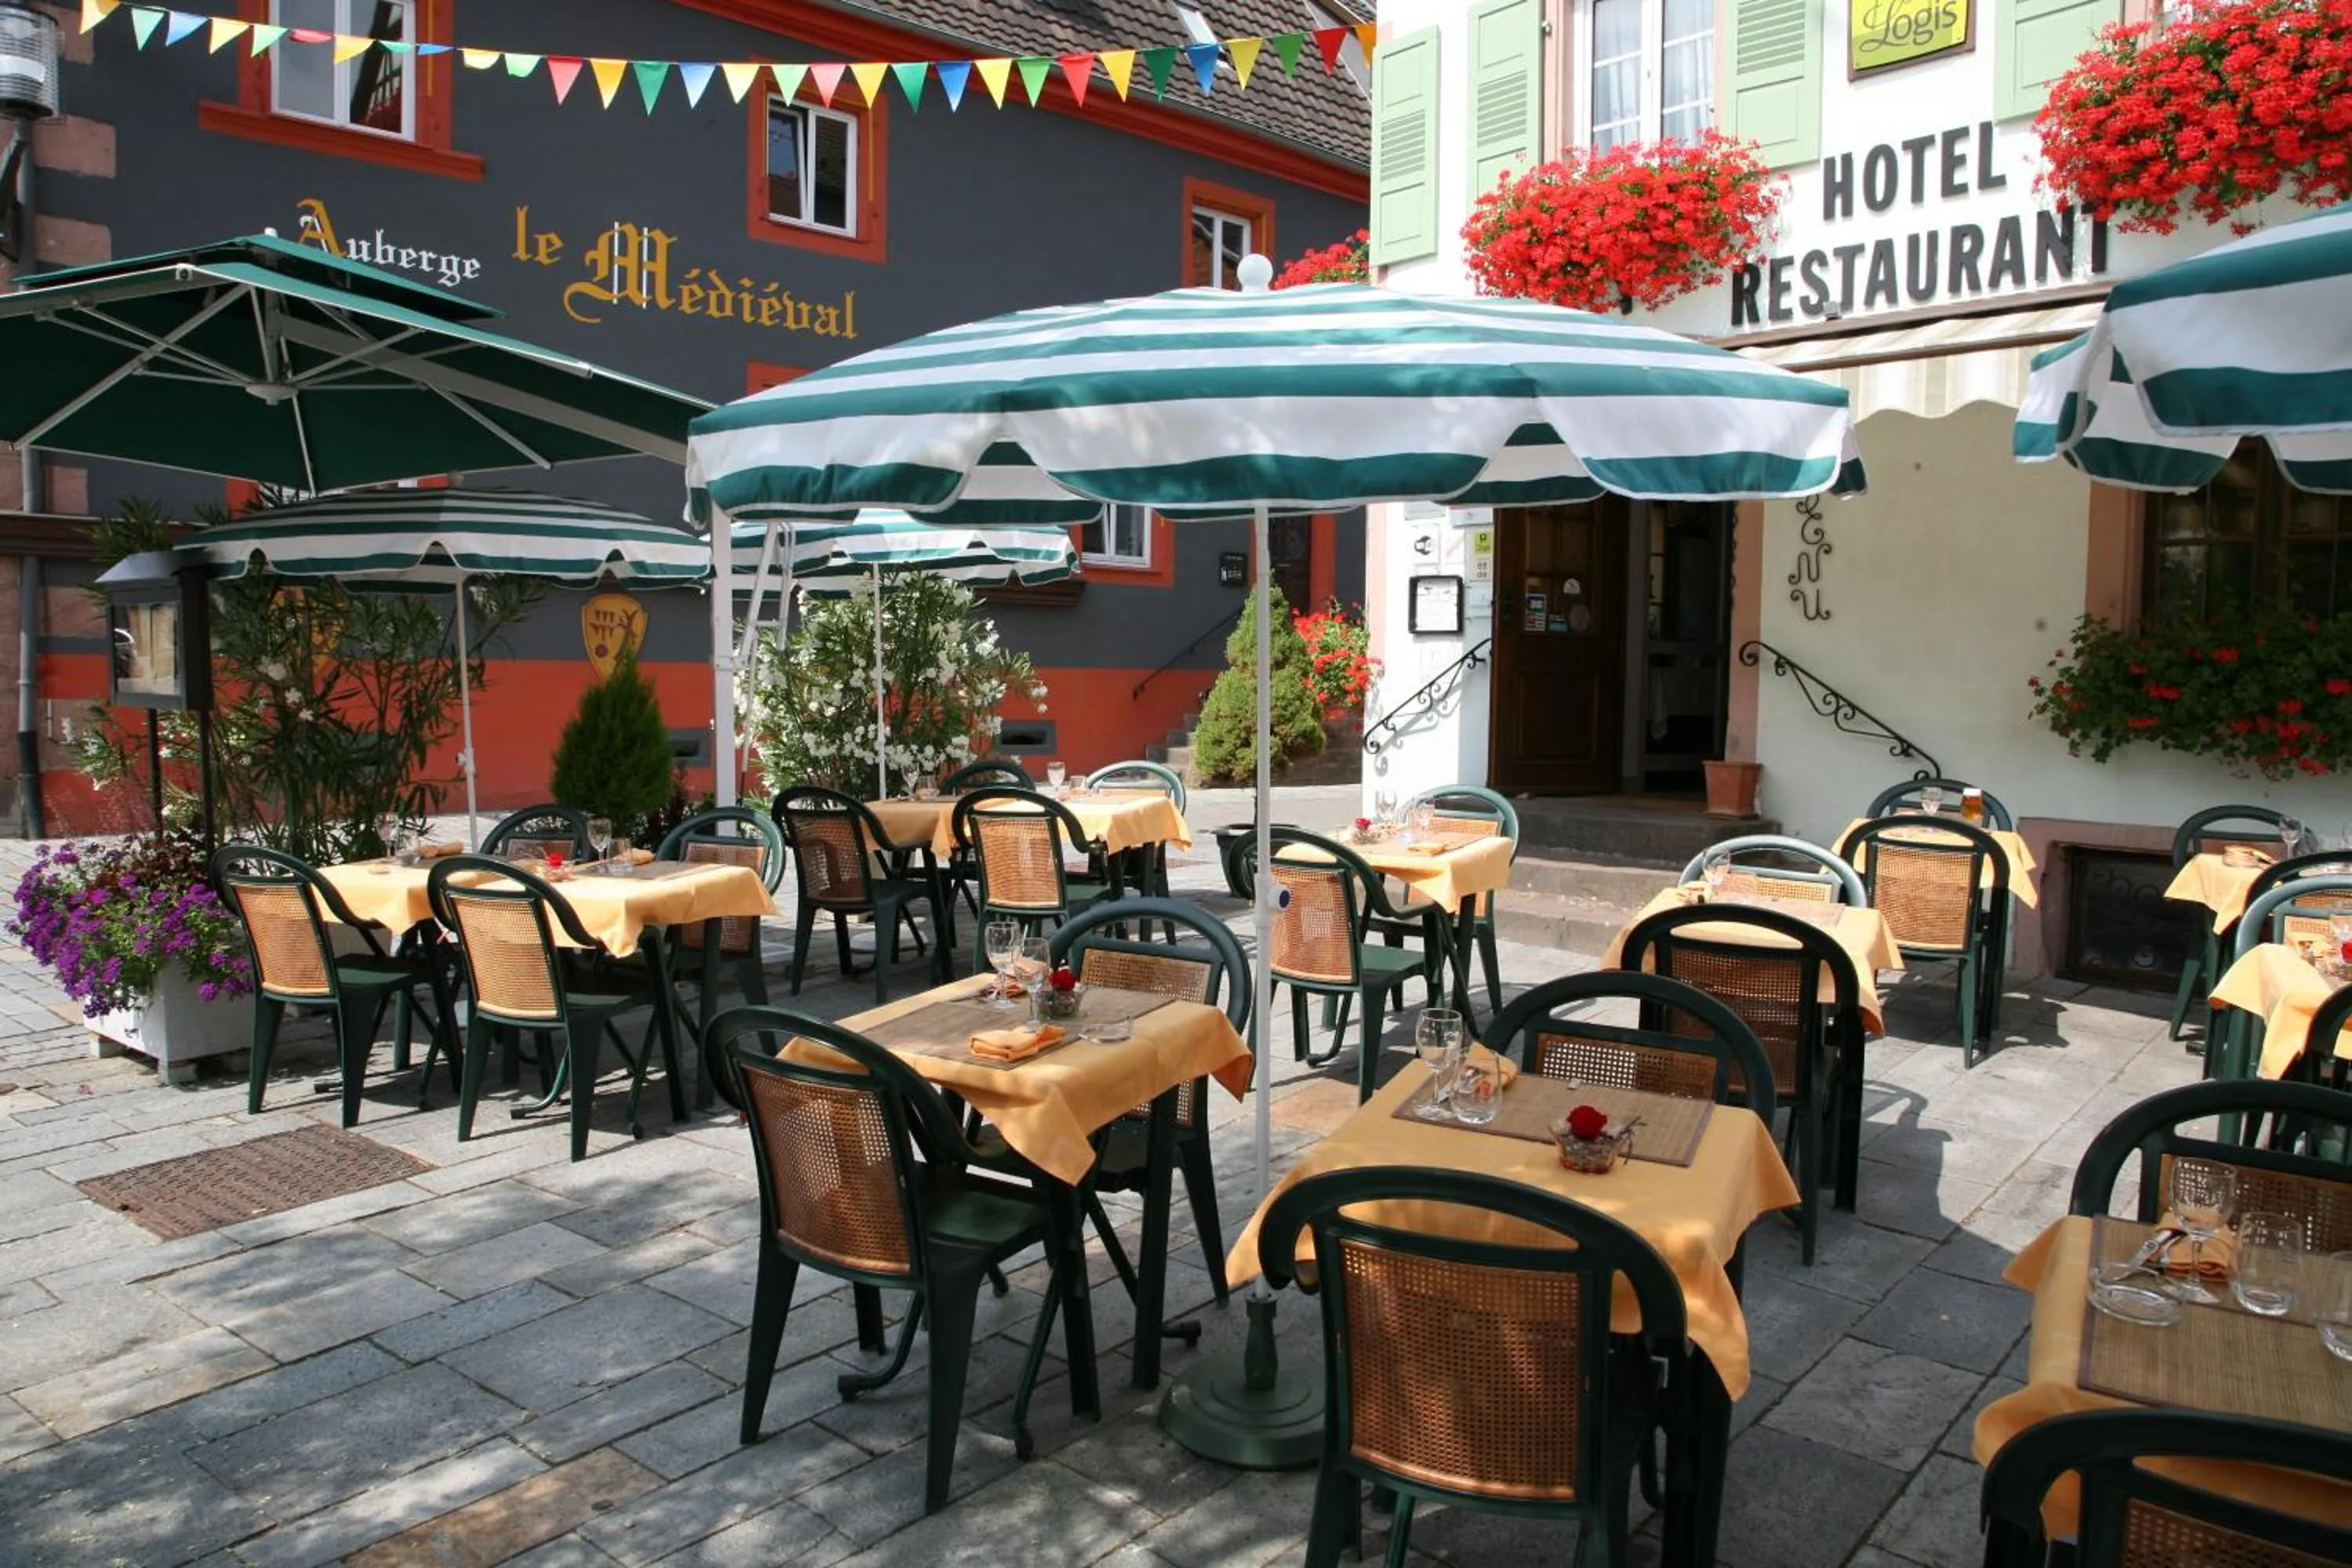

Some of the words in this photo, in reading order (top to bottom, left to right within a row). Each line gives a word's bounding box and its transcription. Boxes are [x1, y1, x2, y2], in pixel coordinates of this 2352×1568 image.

[1859, 0, 1958, 53] Logis
[1823, 121, 2007, 221] HOTEL
[296, 198, 481, 288] Auberge
[511, 205, 564, 265] le
[563, 221, 858, 340] Médiéval
[1731, 199, 2114, 326] RESTAURANT
